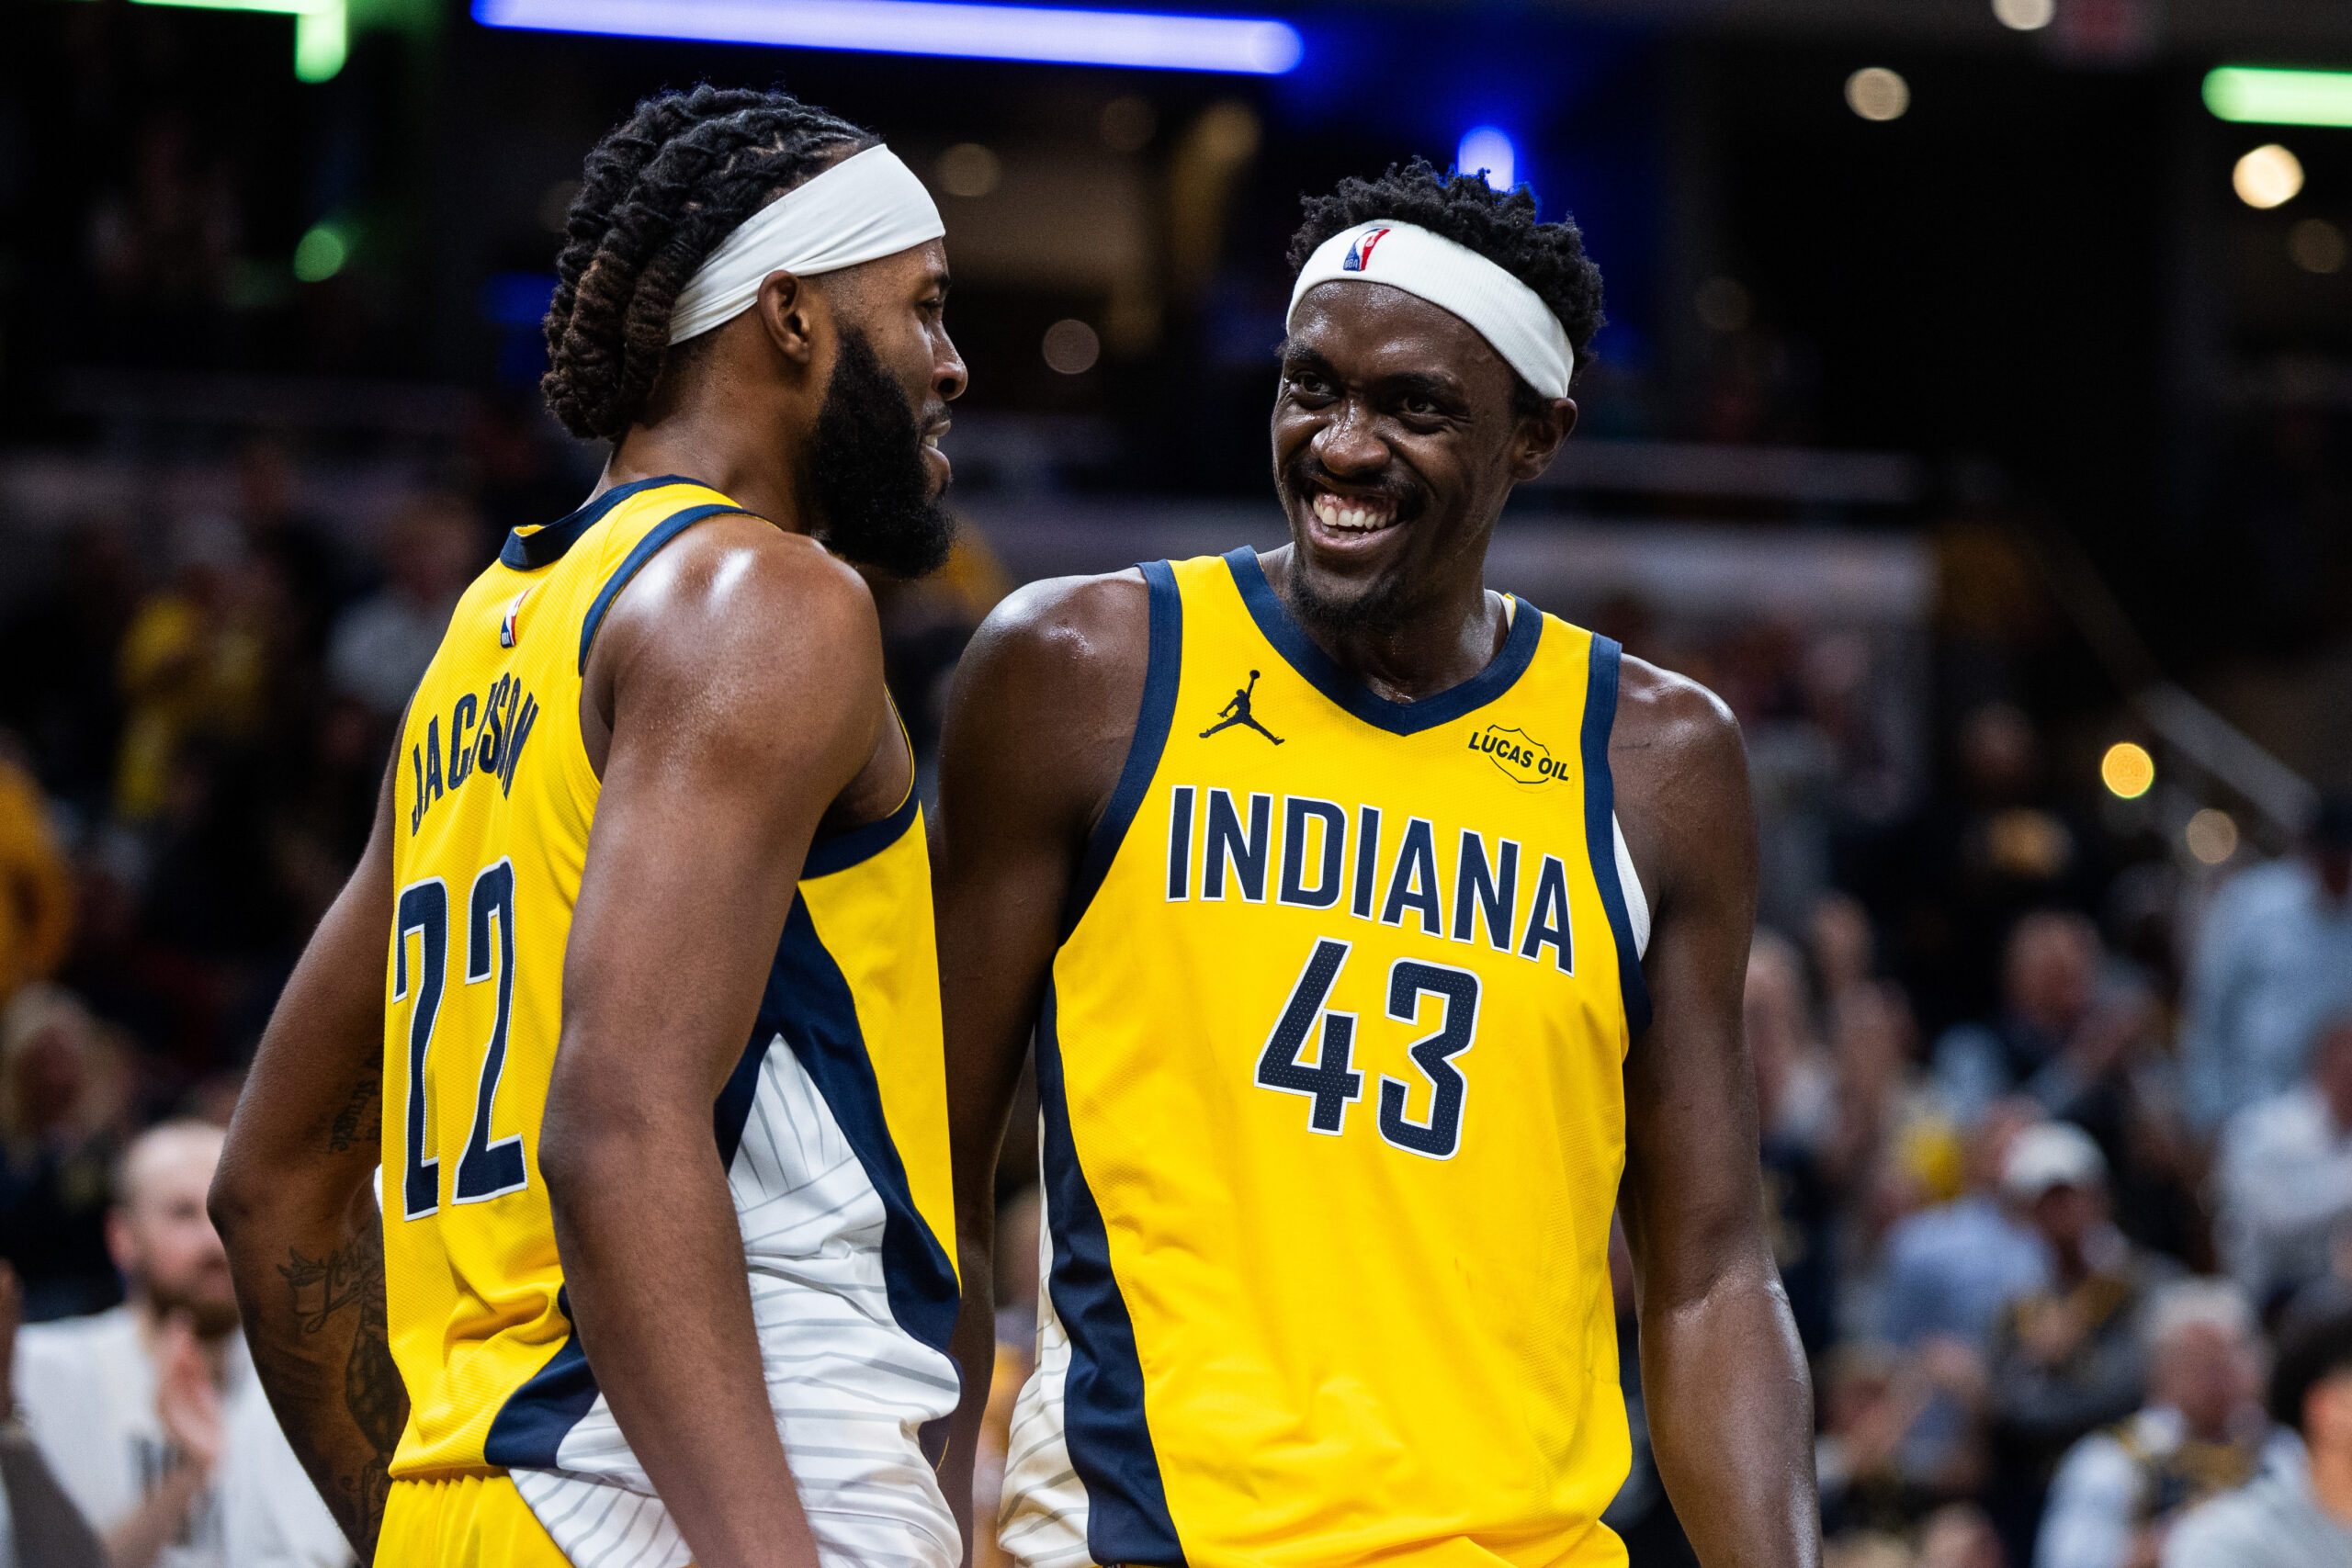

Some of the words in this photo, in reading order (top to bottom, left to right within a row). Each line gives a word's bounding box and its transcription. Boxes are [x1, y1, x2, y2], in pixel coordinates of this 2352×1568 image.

[1468, 731, 1533, 768] LUCAS
[1538, 757, 1569, 781] OIL
[1166, 784, 1574, 977] INDIANA
[392, 855, 528, 1222] 22
[1253, 935, 1483, 1161] 43
